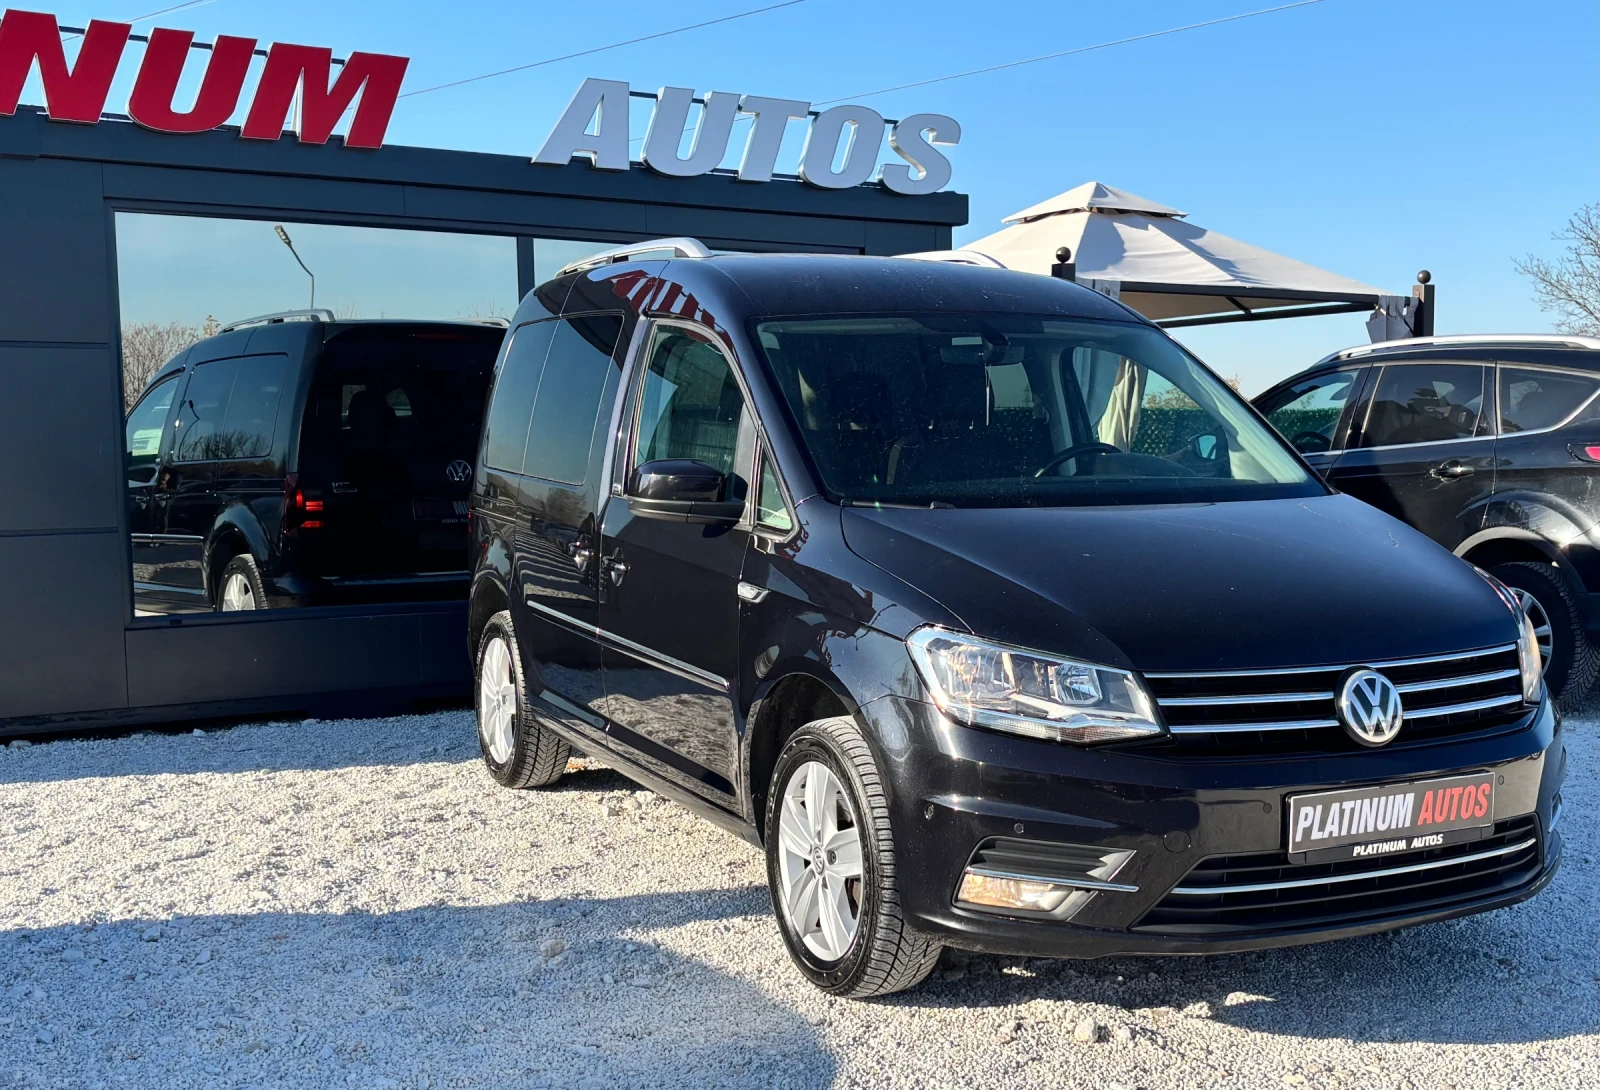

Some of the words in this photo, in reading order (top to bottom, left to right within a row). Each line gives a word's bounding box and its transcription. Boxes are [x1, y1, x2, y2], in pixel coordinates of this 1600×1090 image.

[531, 77, 962, 196] AUTOS
[1295, 792, 1415, 843] PLATINUM
[1417, 782, 1491, 826] AUTOS
[1352, 839, 1407, 857] PLATINUM
[1410, 833, 1444, 849] AUTOS
